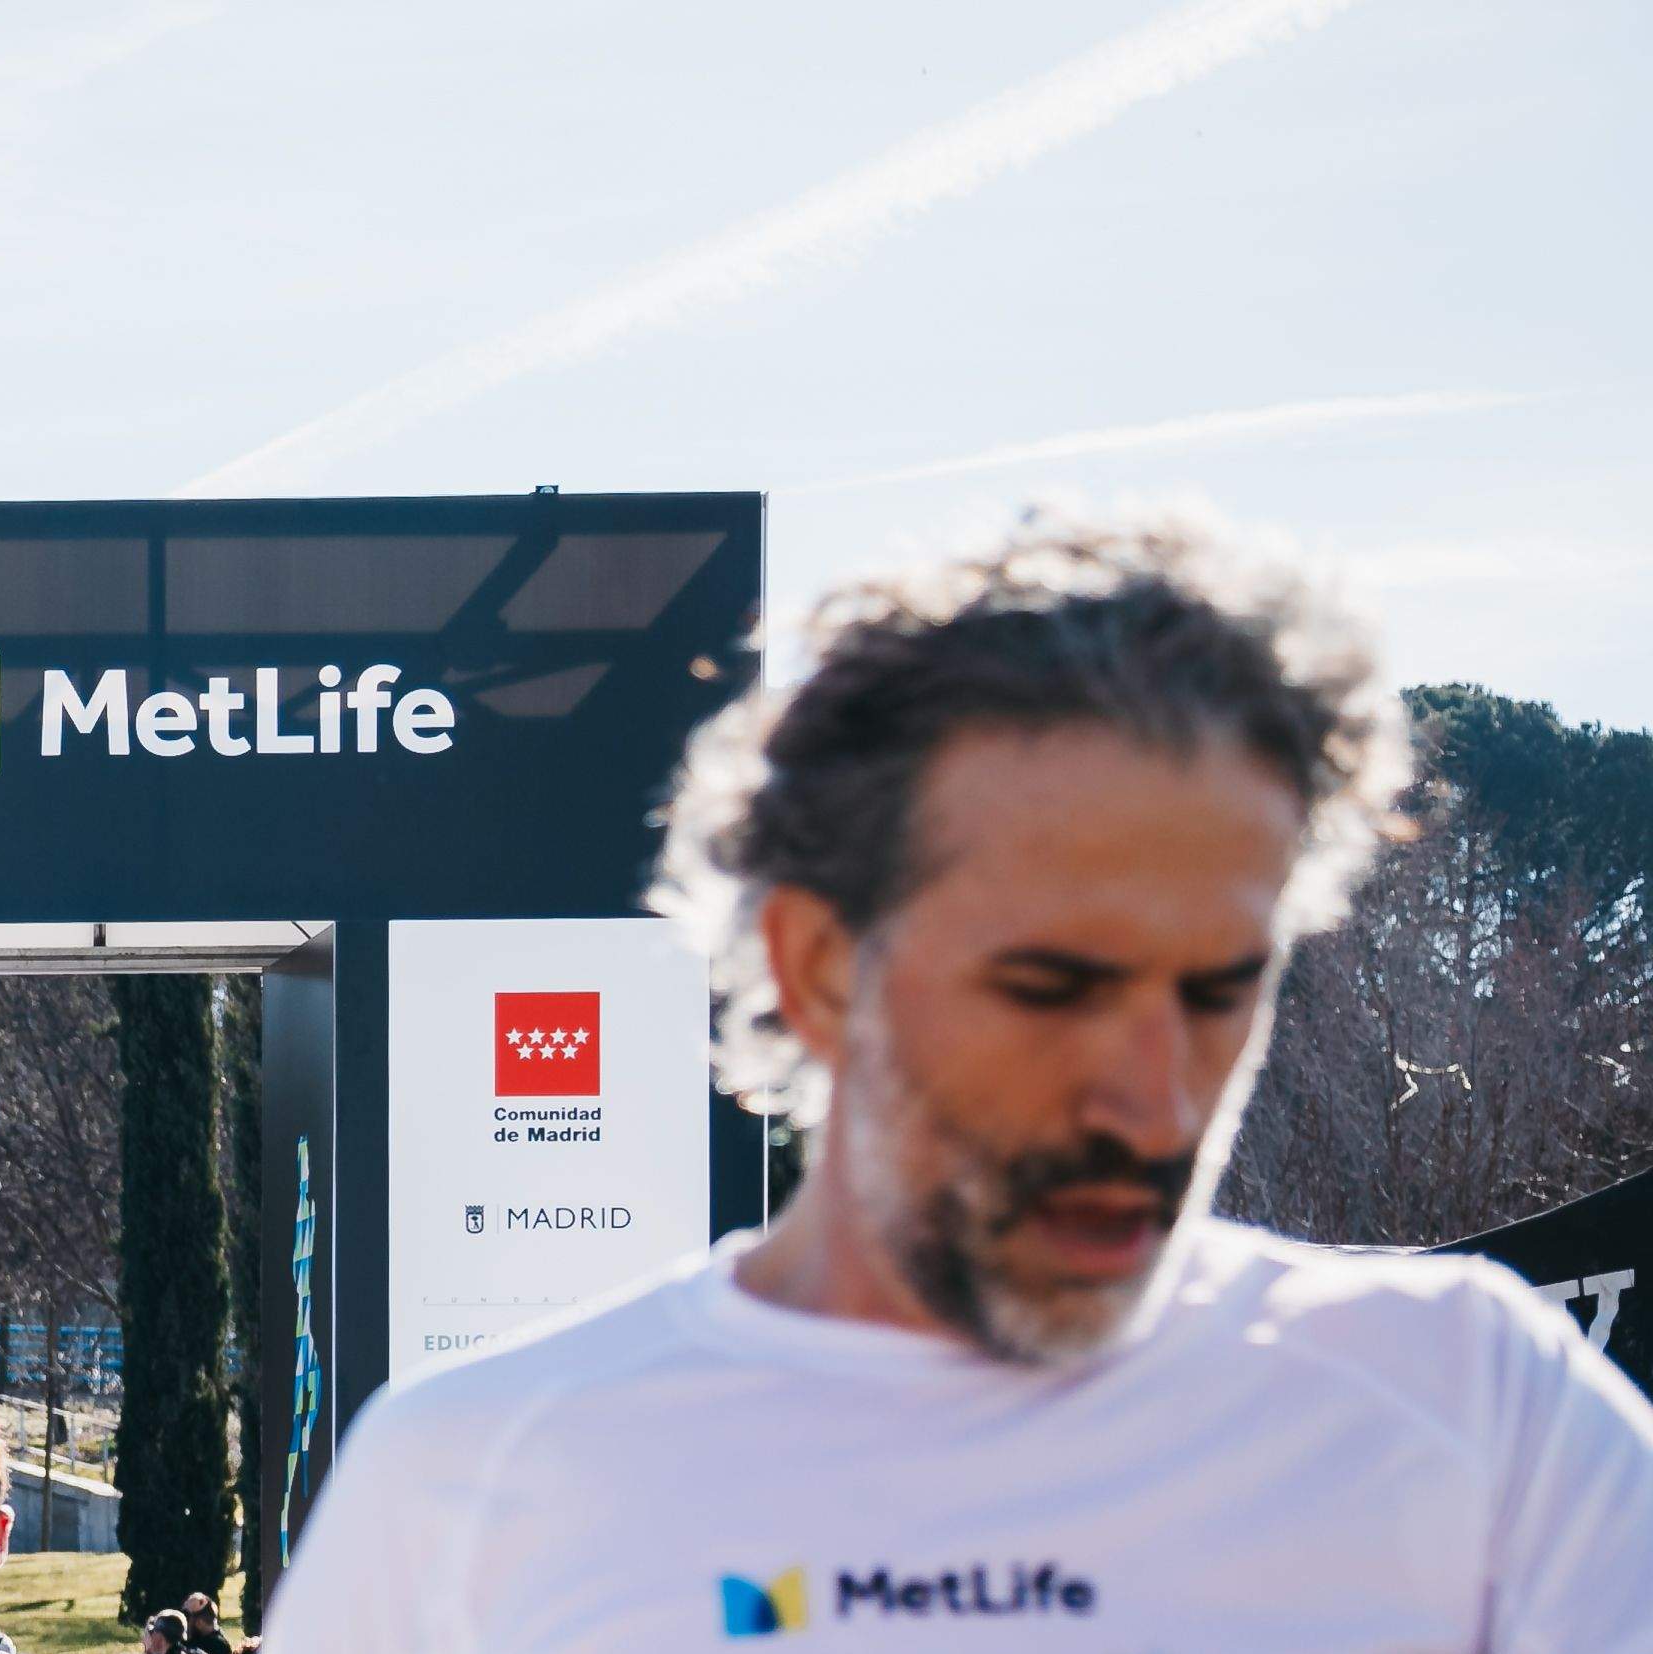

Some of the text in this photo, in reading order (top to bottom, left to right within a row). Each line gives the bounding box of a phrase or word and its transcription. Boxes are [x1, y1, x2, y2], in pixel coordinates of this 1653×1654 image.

[40, 664, 456, 757] MetLife
[494, 1107, 602, 1121] Comunidad
[494, 1127, 602, 1142] de Madrid
[506, 1206, 632, 1230] MADRID
[833, 1560, 1100, 1618] MetLife
